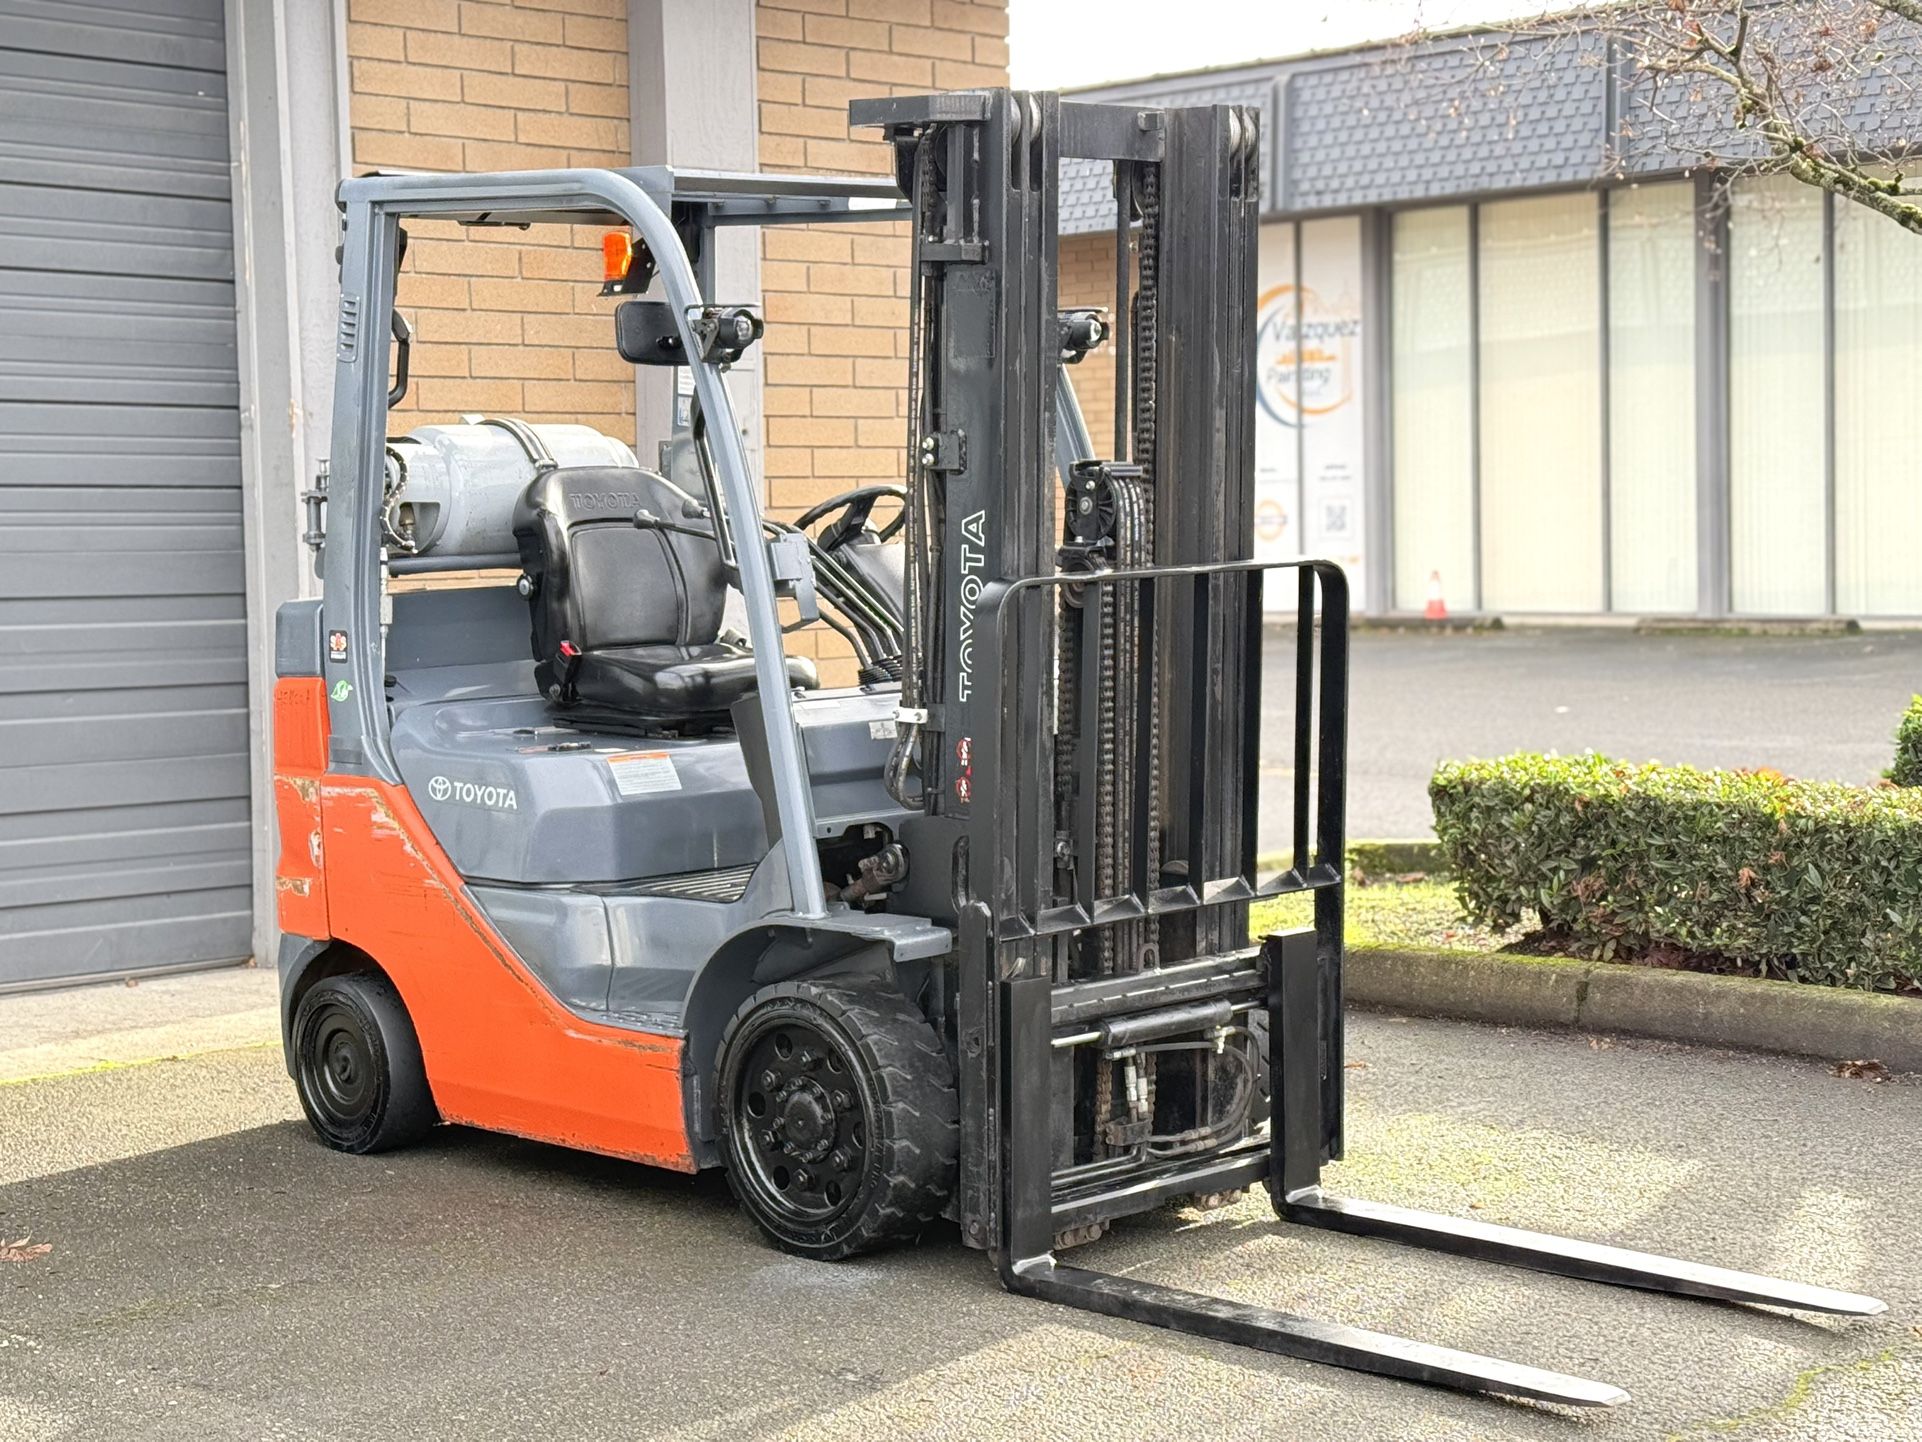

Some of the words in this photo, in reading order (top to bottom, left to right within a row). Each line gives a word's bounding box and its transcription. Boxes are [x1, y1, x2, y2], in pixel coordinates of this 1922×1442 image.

[568, 491, 641, 512] TOYOTA
[959, 509, 985, 702] TOYOTA
[453, 781, 518, 810] TOYOTA
